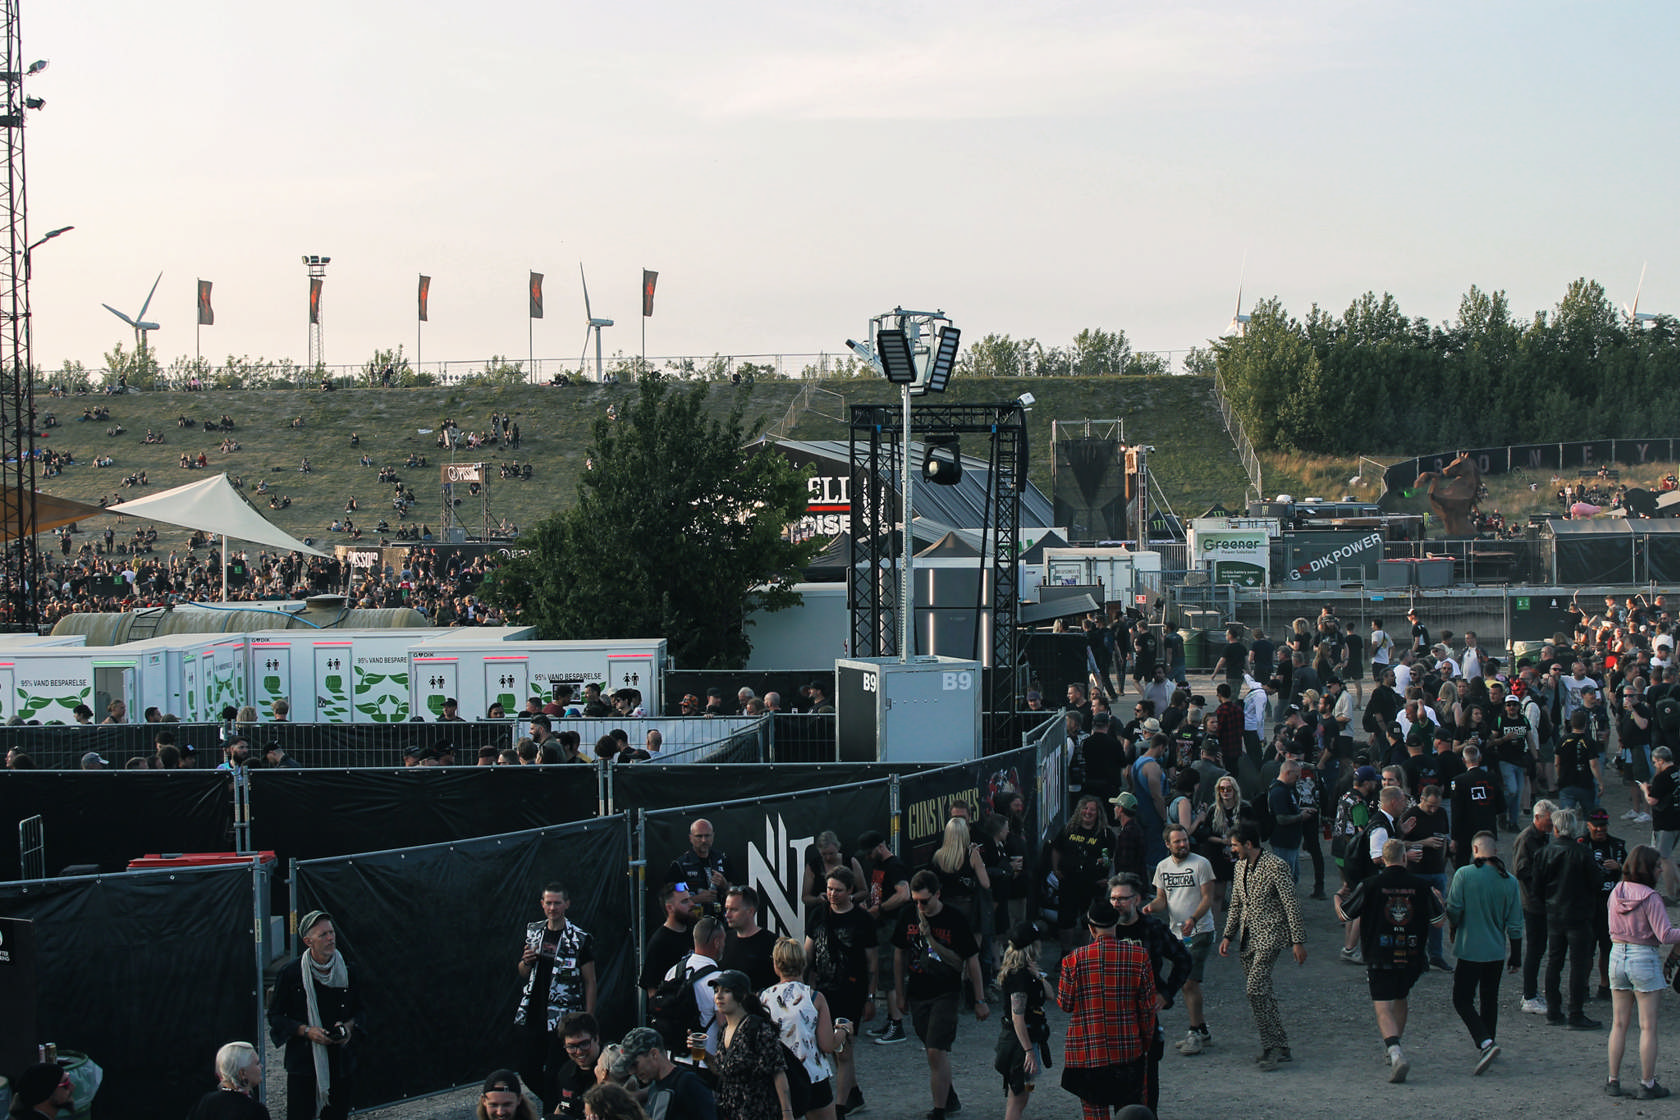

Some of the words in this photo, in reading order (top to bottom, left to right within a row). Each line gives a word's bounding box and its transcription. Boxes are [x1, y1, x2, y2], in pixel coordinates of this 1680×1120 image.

[1203, 538, 1260, 551] Greener
[1332, 533, 1383, 562] POWER
[50, 679, 87, 687] BESPARELSE
[565, 672, 602, 680] BESPARELSE
[863, 672, 877, 693] B9
[942, 672, 972, 691] B9
[908, 797, 937, 841] GUNS
